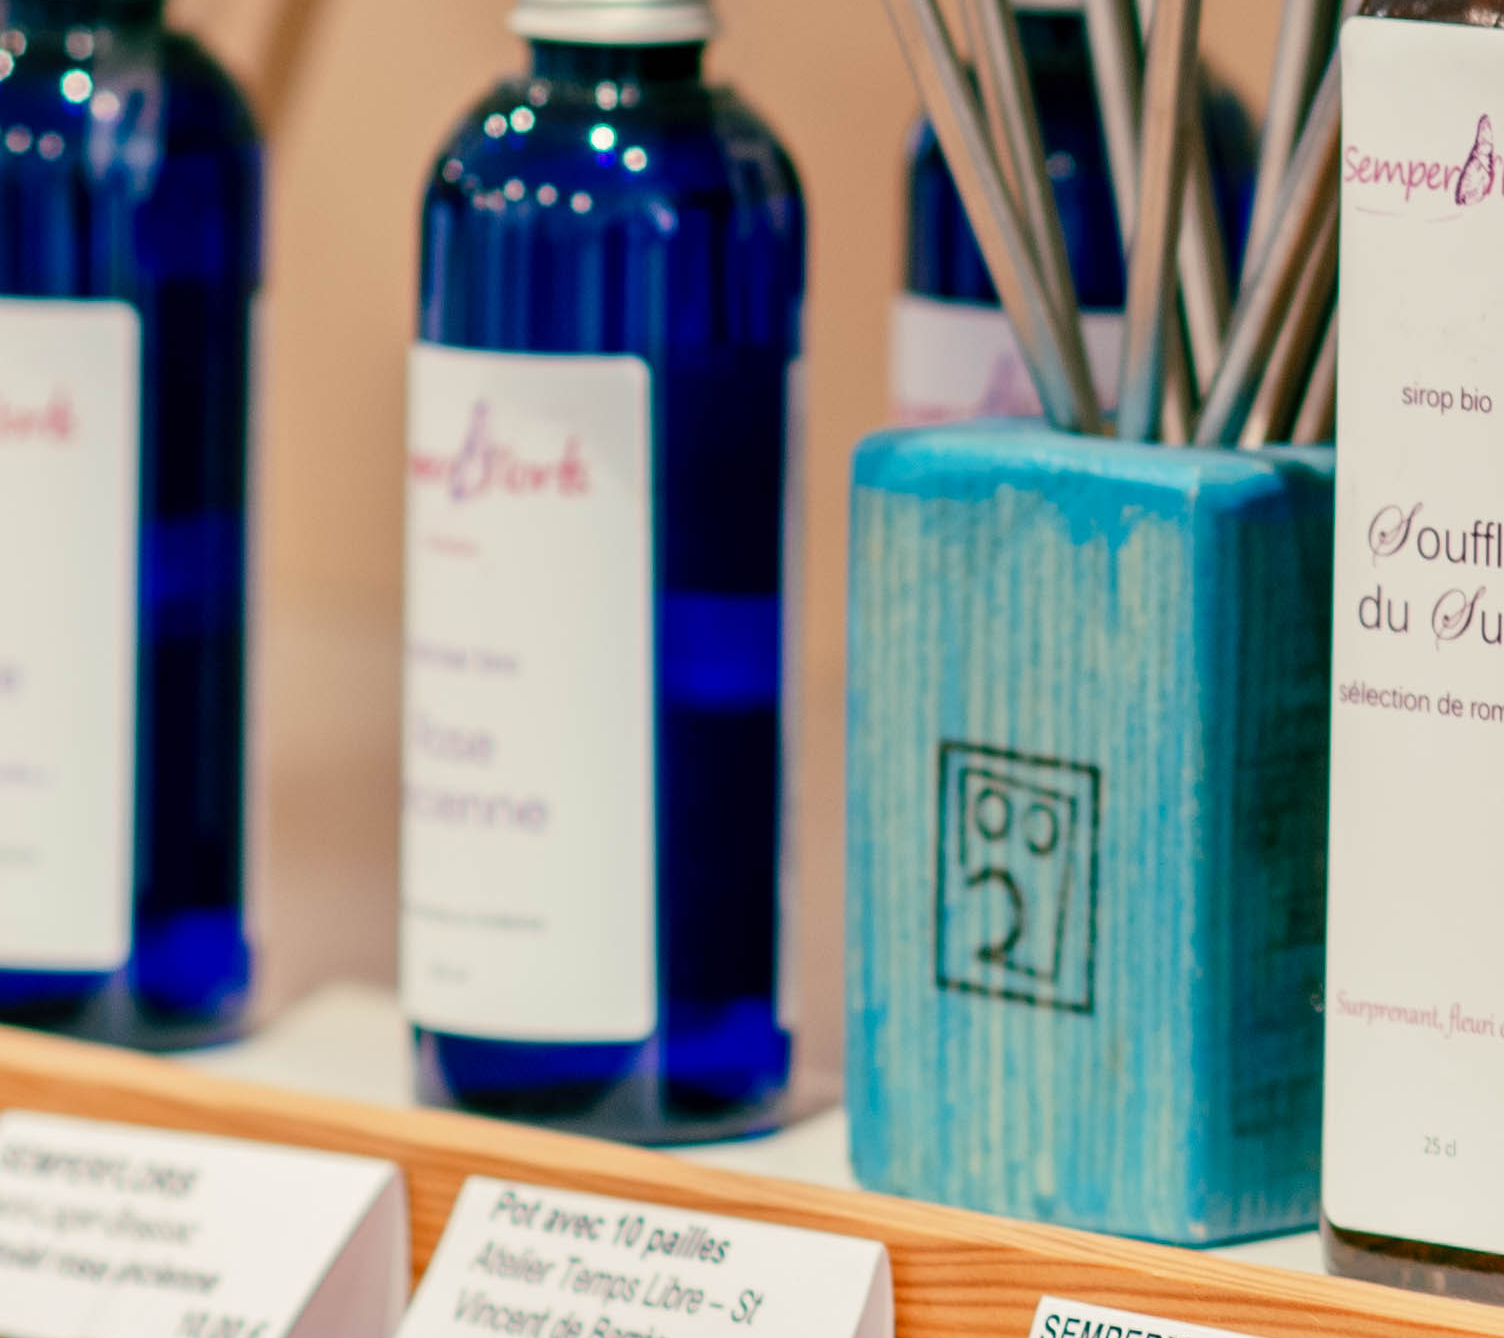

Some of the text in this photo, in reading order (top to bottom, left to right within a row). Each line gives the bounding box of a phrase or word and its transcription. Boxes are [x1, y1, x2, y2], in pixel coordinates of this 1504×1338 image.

[1401, 381, 1494, 415] sirop bio
[1359, 587, 1410, 634] du
[1339, 679, 1431, 715] sélection
[1437, 687, 1464, 719] de
[1446, 1001, 1495, 1042] fleuri
[1423, 1134, 1457, 1159] 25 cl
[490, 1190, 732, 1267] Pot avec 10 pailles
[472, 1240, 764, 1327] Atelier Temps Libre St
